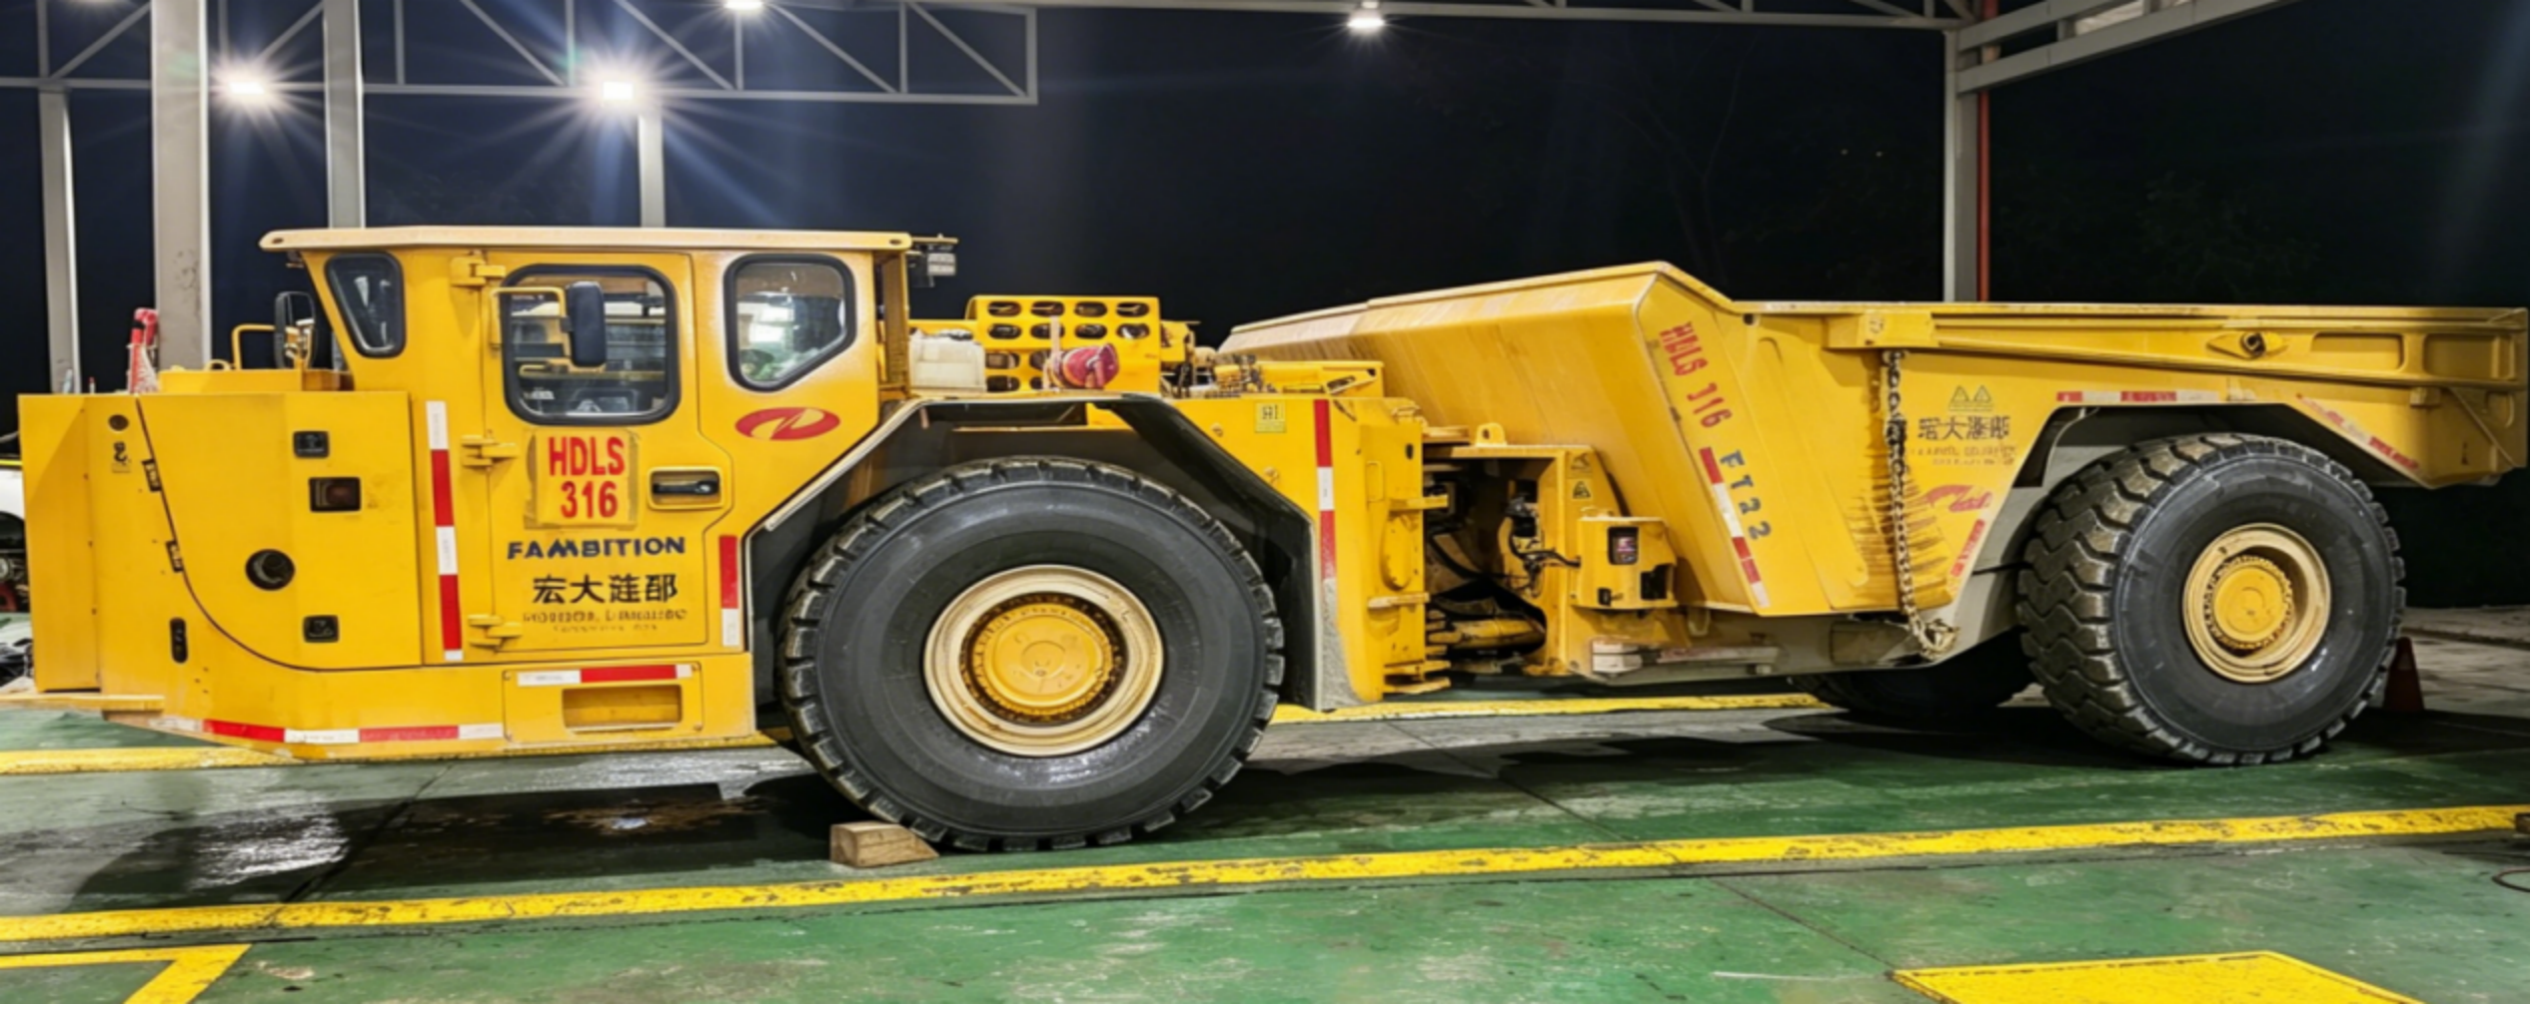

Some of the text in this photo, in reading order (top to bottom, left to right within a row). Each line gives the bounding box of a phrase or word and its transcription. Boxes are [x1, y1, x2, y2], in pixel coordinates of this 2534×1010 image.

[549, 436, 625, 476] HDLS
[560, 481, 618, 519] 316
[507, 537, 685, 559] FAMBITION
